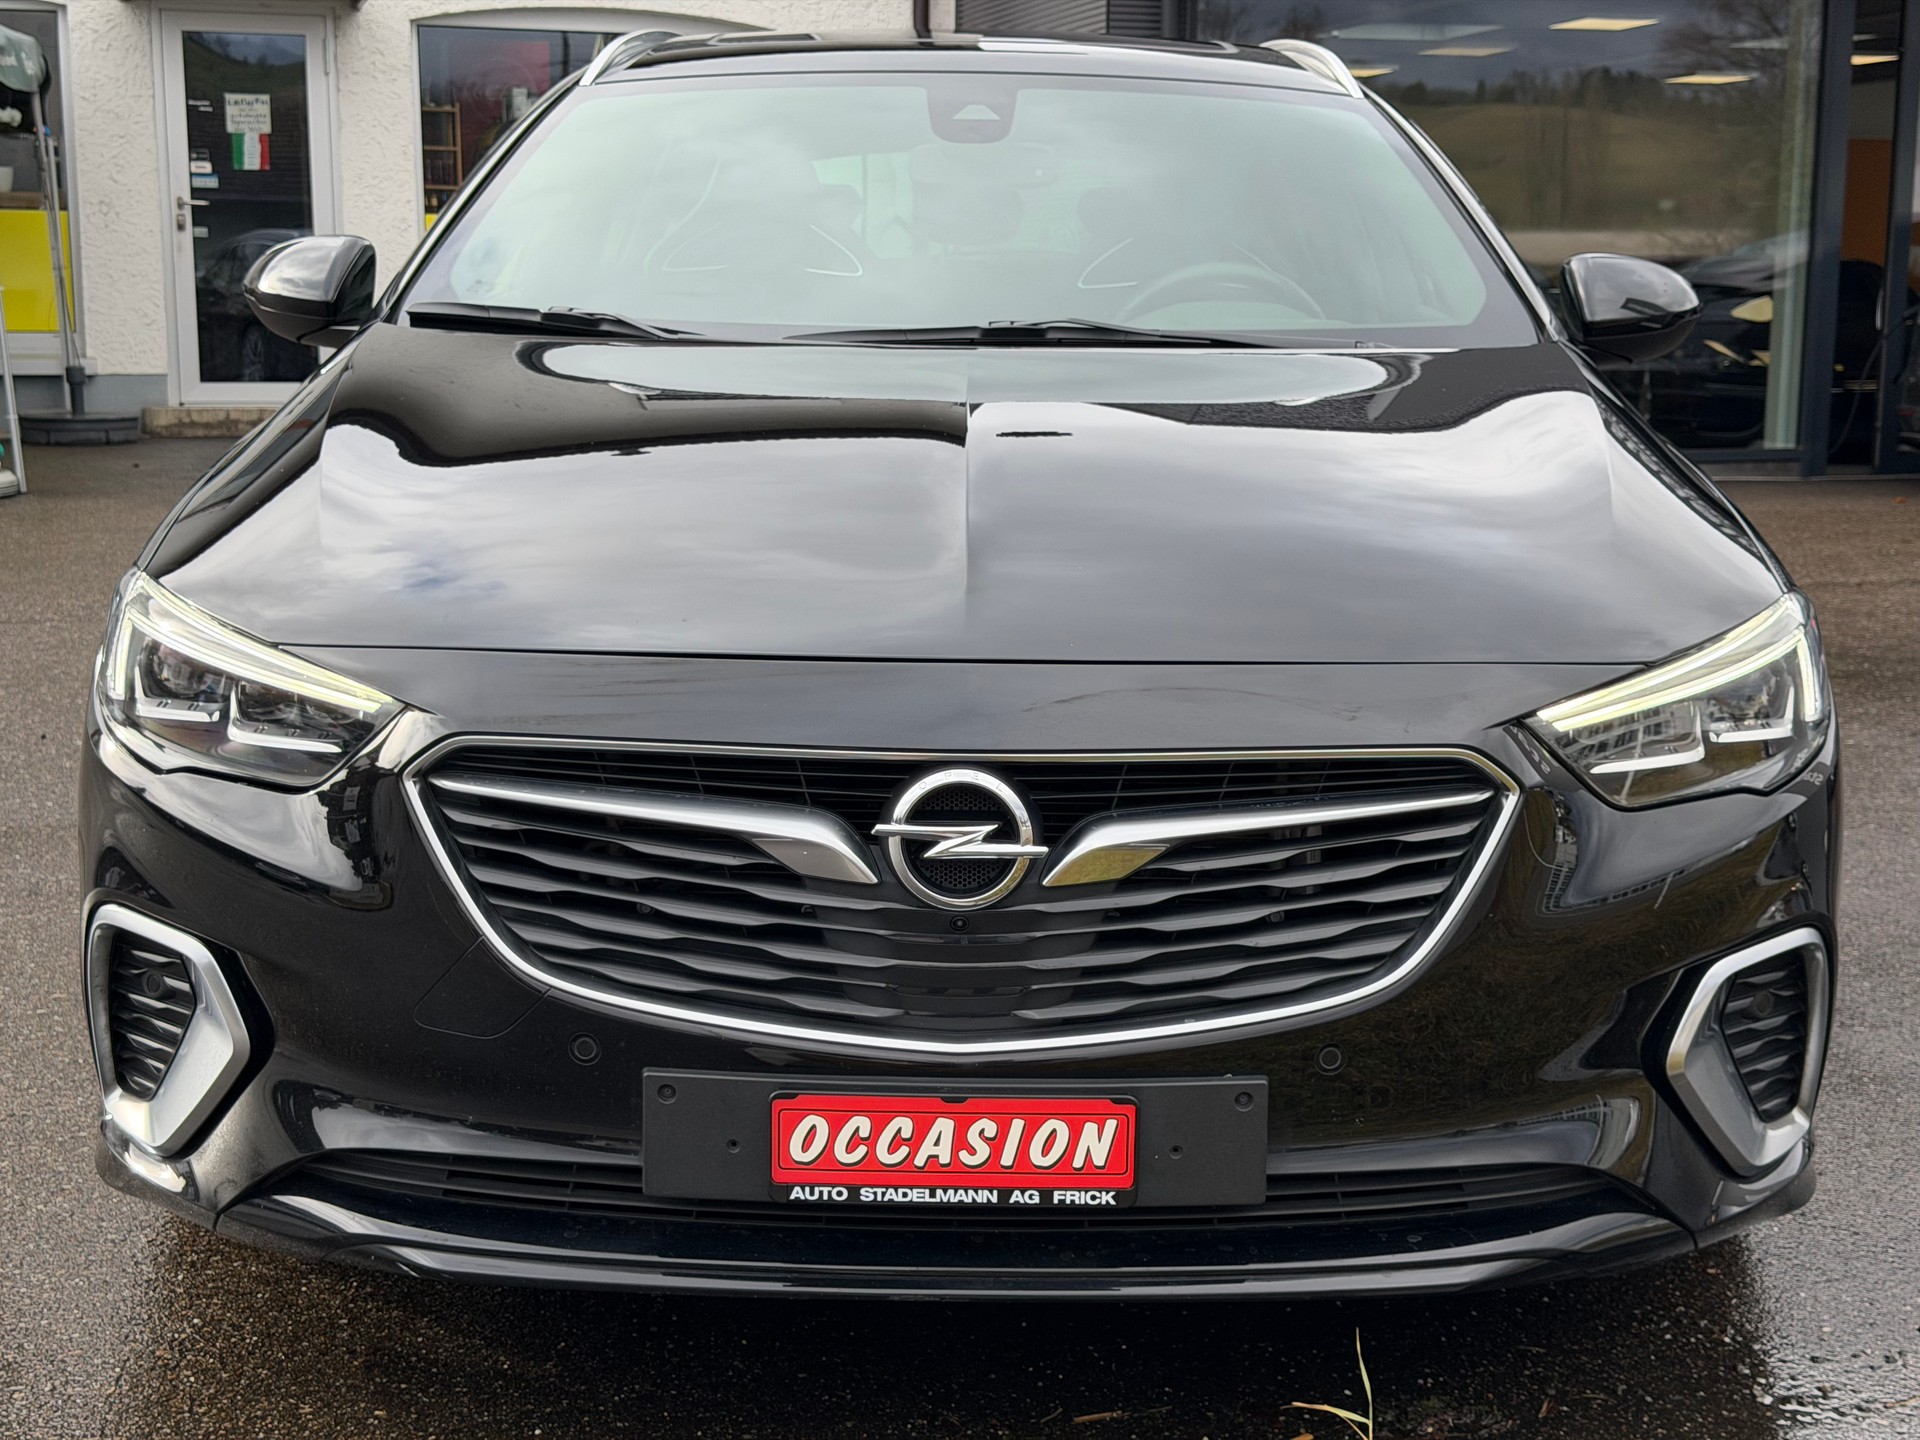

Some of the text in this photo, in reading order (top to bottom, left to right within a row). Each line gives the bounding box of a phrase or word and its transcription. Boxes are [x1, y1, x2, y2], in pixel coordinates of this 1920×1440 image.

[919, 771, 1003, 793] OPEL
[789, 1114, 1119, 1172] OCCASION
[790, 1186, 1116, 1205] AUTO STADELMANN AG FRICK
